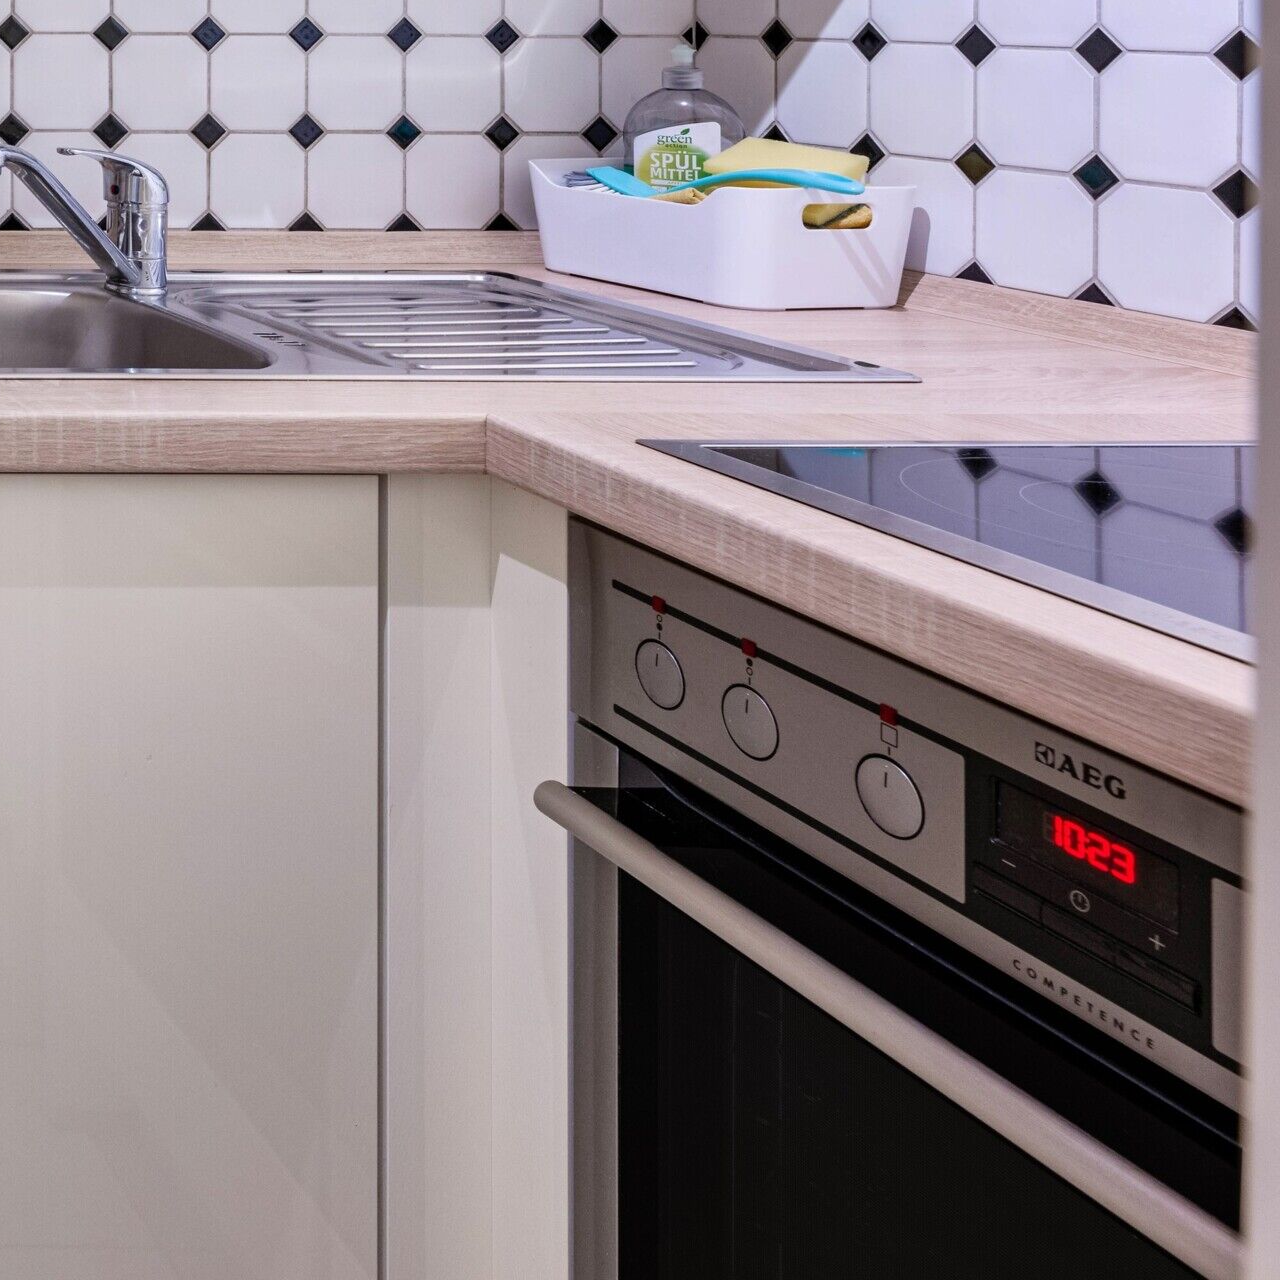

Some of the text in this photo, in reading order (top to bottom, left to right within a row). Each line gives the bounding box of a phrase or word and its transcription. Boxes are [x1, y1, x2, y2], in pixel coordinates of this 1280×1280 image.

[657, 134, 692, 145] green
[650, 151, 702, 170] SPÜL
[1057, 753, 1127, 800] AEG
[1013, 959, 1155, 1049] COMPETENCE
